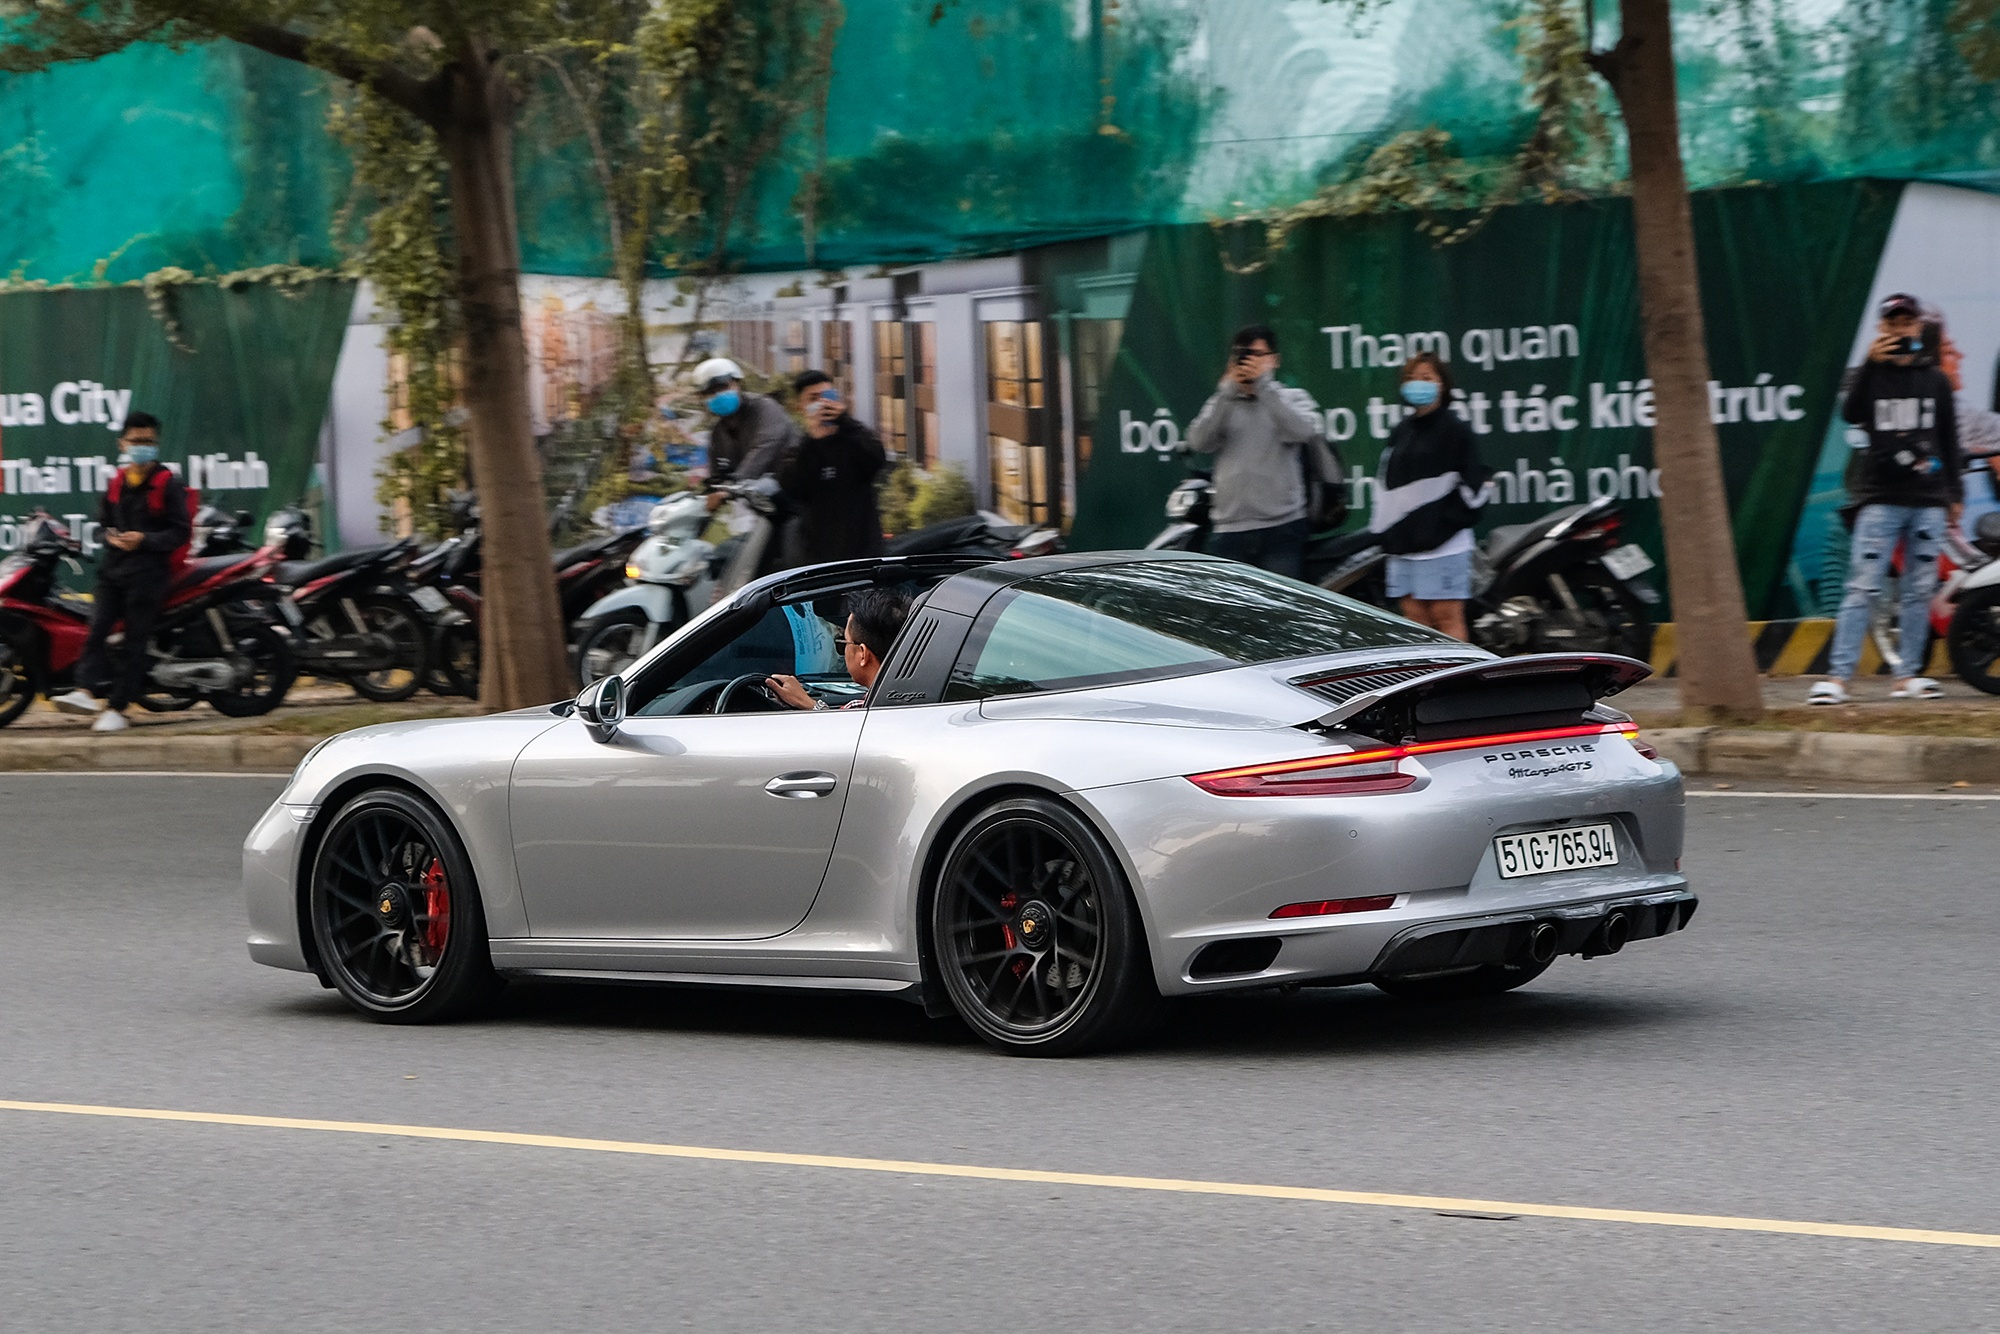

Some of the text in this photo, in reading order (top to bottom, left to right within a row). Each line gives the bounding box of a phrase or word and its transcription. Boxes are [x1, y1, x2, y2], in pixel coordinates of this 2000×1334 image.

[1320, 323, 1580, 372] Tham quan
[51, 379, 133, 432] City
[1500, 383, 1580, 433] tác
[1706, 372, 1807, 425] trúc
[1488, 456, 1575, 505] nhà
[1483, 744, 1596, 764] PORSCHE
